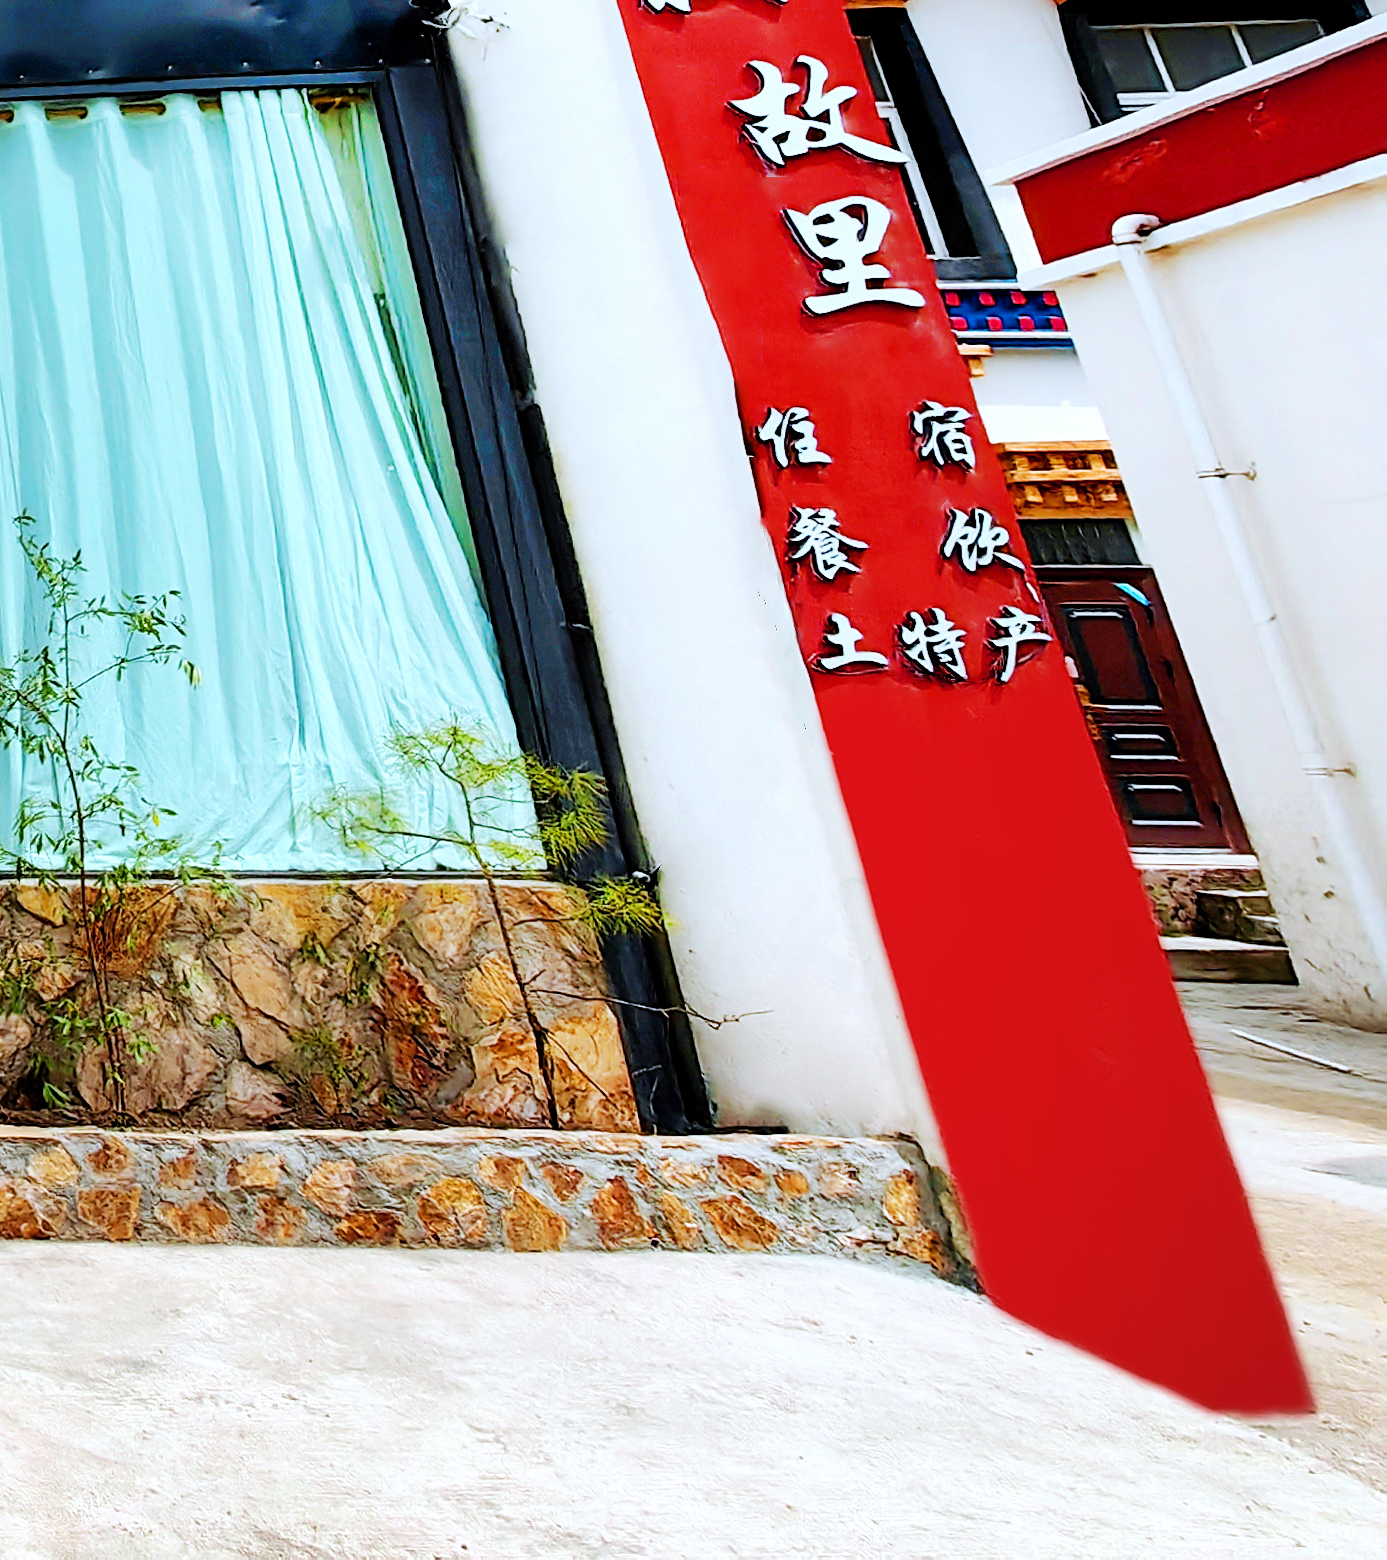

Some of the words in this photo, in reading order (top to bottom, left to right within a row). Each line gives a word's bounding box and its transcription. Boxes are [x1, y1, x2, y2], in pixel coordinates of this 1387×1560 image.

[757, 401, 976, 473] 住宿
[788, 507, 1026, 580] 餐饮
[817, 605, 1053, 683] 土特产
